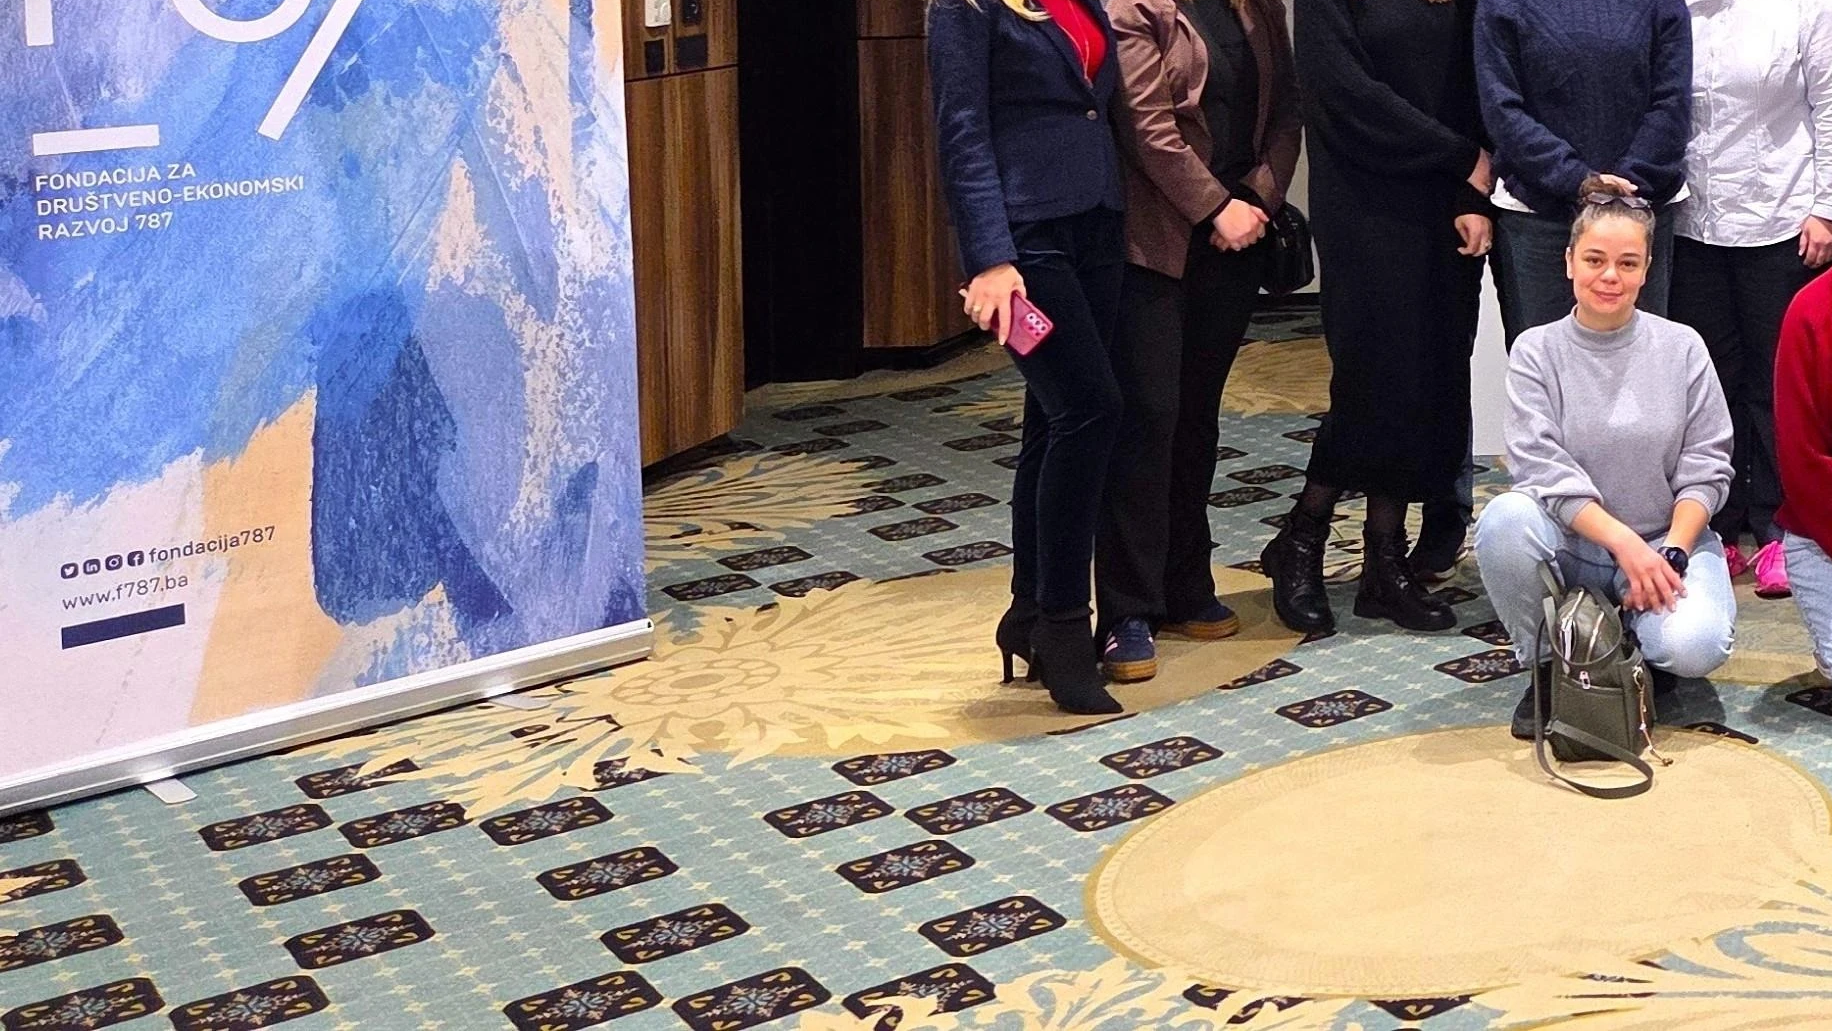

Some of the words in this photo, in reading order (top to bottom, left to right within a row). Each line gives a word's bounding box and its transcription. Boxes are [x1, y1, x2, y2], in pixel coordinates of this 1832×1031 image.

[35, 166, 162, 193] FONDACIJA
[167, 162, 197, 180] ZA
[36, 174, 305, 217] DRUŠTVENO-EKONOMSKI
[38, 216, 129, 241] RAZVOJ
[134, 211, 174, 230] 787
[149, 525, 276, 564] fondacija787
[62, 573, 189, 611] www.f787.ba
